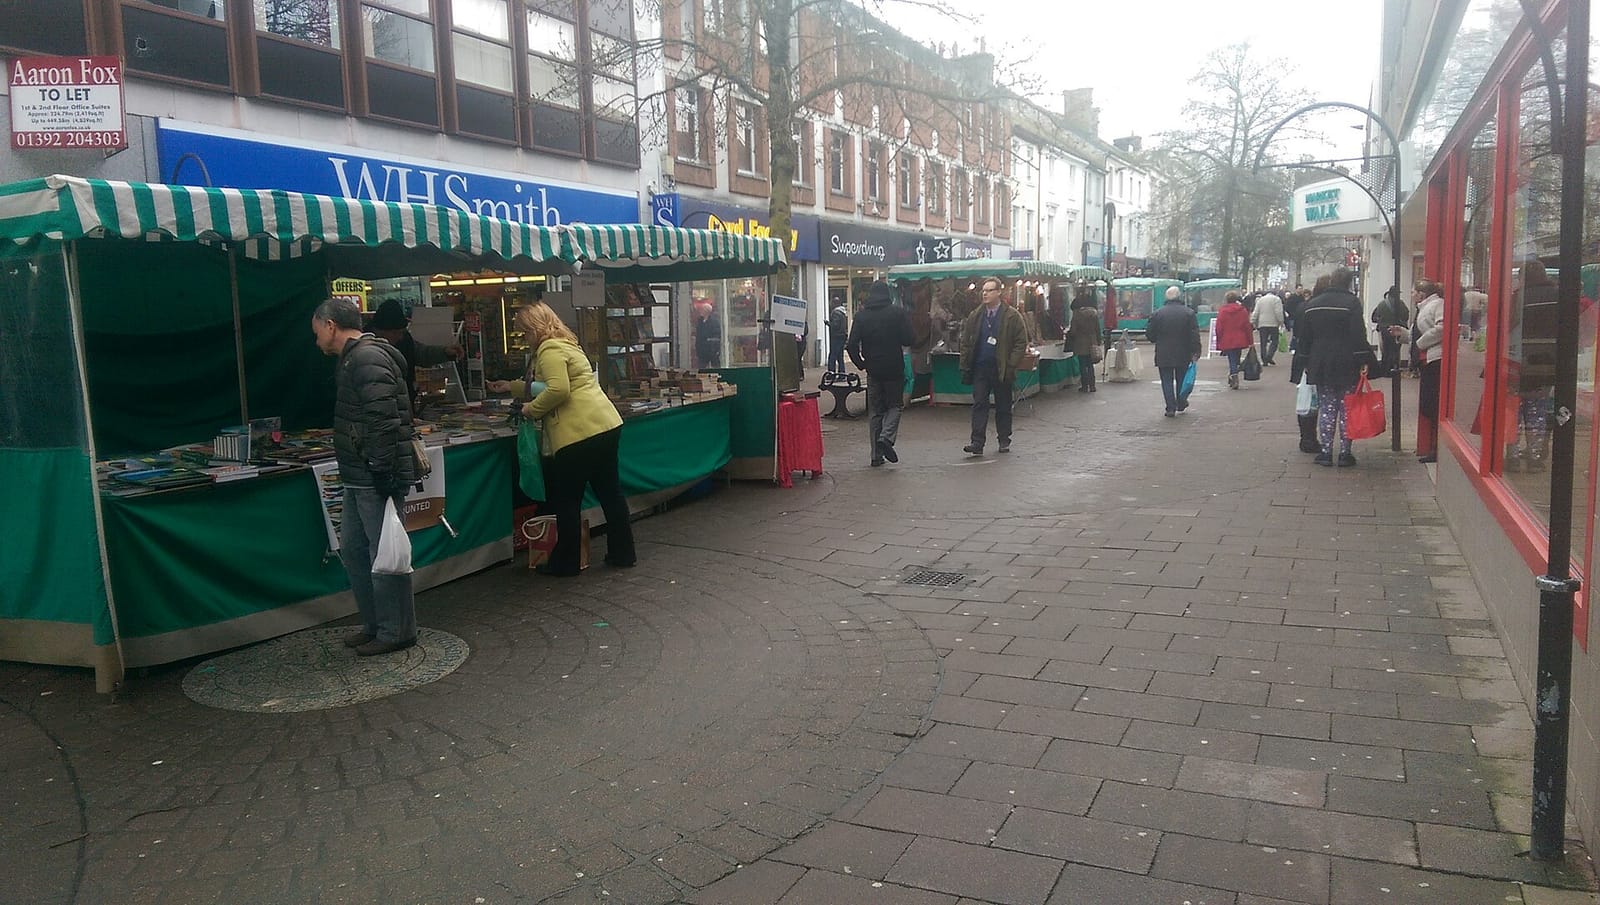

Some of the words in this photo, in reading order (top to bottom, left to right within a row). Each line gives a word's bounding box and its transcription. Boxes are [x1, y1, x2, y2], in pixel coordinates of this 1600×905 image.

[11, 60, 74, 85] Aaron
[79, 59, 119, 84] Fox
[39, 88, 60, 101] TO
[66, 88, 91, 101] LET
[16, 133, 62, 146] 01392
[66, 132, 120, 146] 204303
[328, 157, 560, 226] WHSmith
[656, 197, 673, 208] WH
[1305, 203, 1339, 222] WALK
[749, 219, 798, 251] Facy
[831, 234, 885, 262] Superdrug
[335, 281, 364, 292] OFFERS
[403, 501, 430, 514] UNTED
